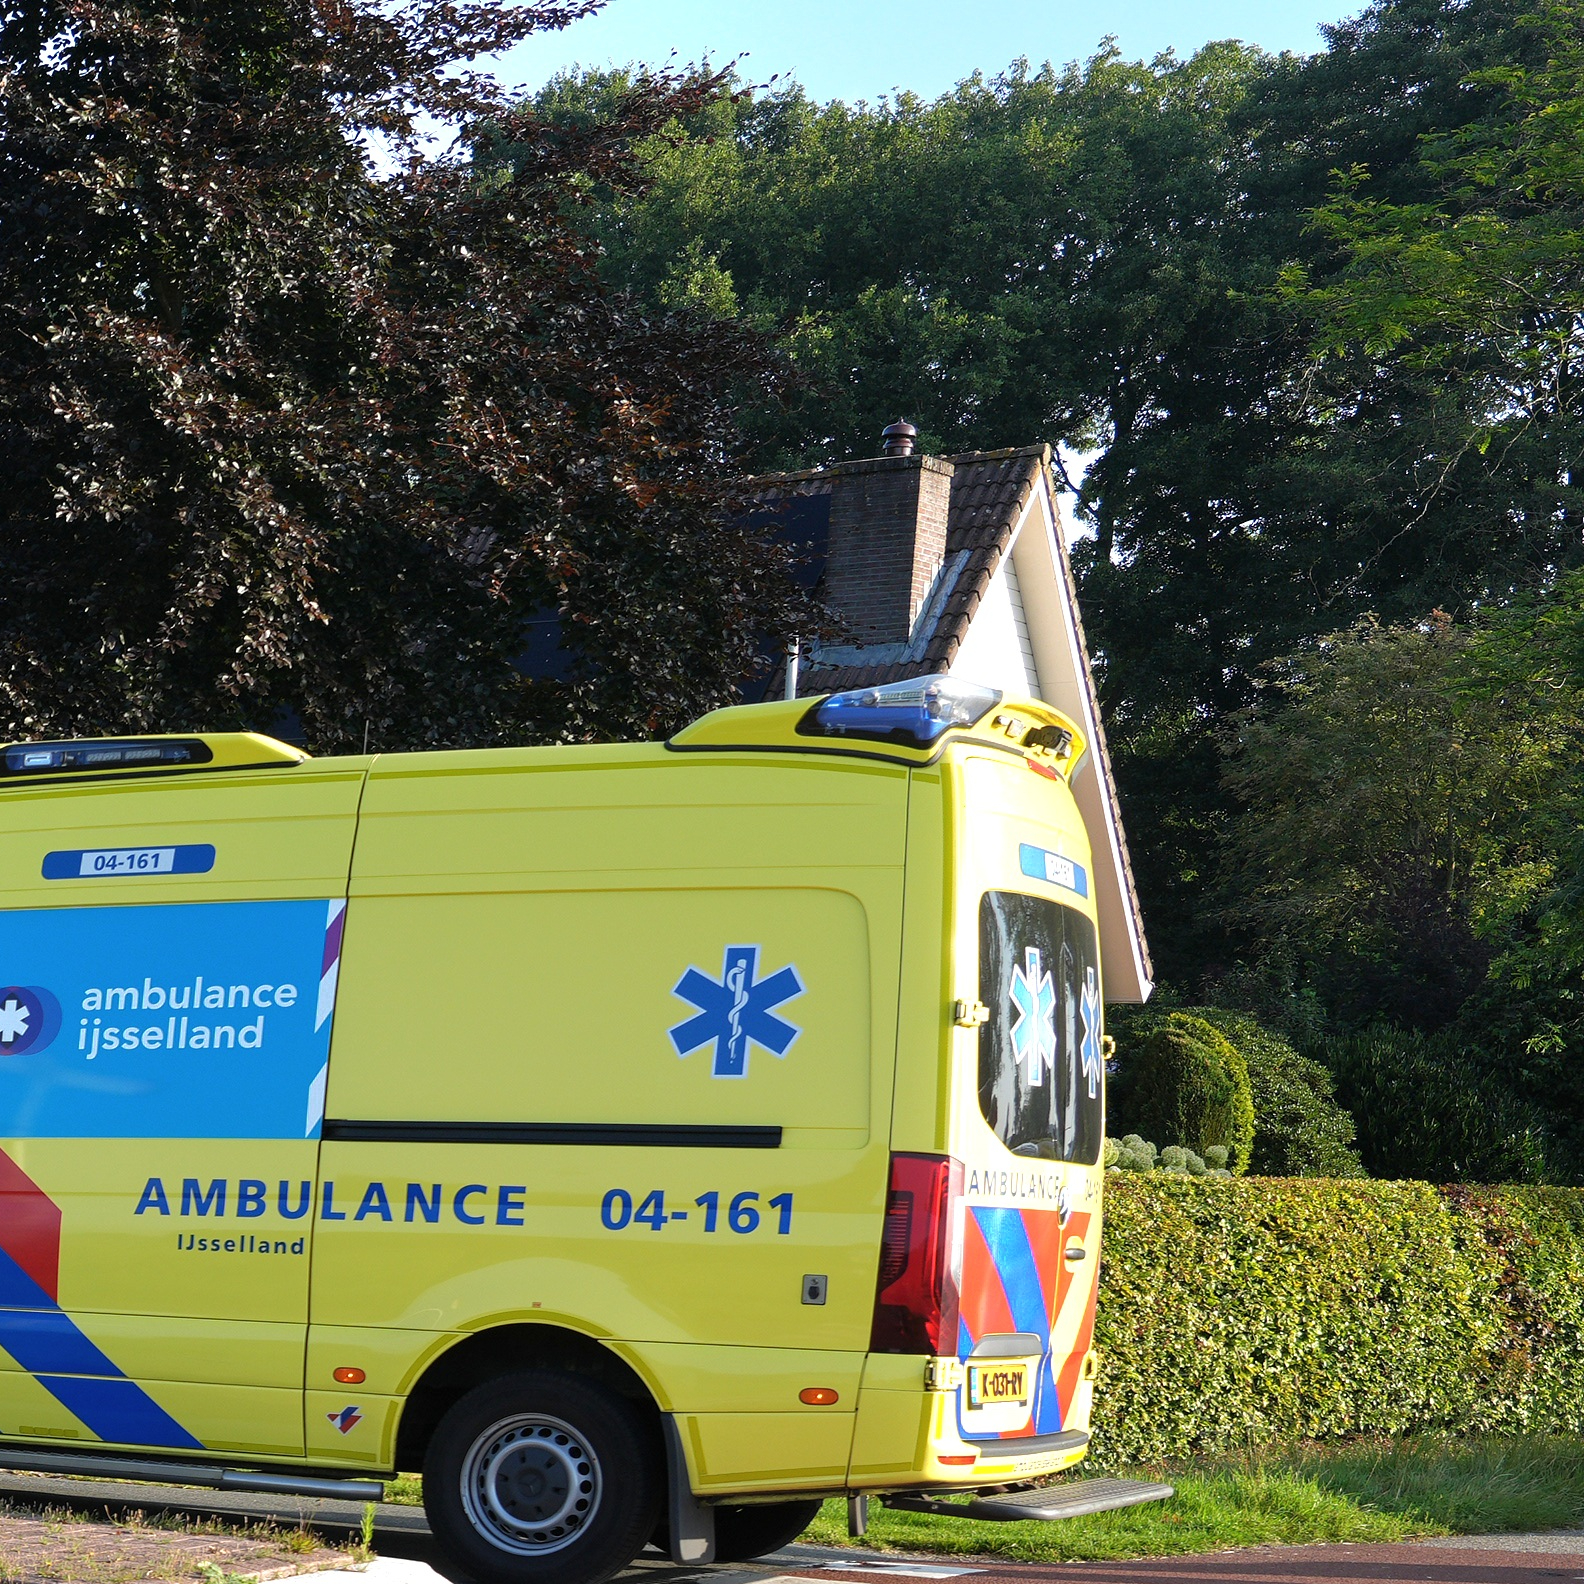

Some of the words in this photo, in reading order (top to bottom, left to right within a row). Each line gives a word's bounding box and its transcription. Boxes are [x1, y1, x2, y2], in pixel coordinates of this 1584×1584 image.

[93, 853, 160, 872] 04-161
[81, 976, 298, 1011] ambulance
[78, 1015, 265, 1060] ijsselland
[135, 1177, 527, 1226] AMBULANCE
[969, 1169, 1060, 1199] AMBULANCE
[601, 1188, 794, 1235] 04-161
[177, 1233, 305, 1255] IJsselland
